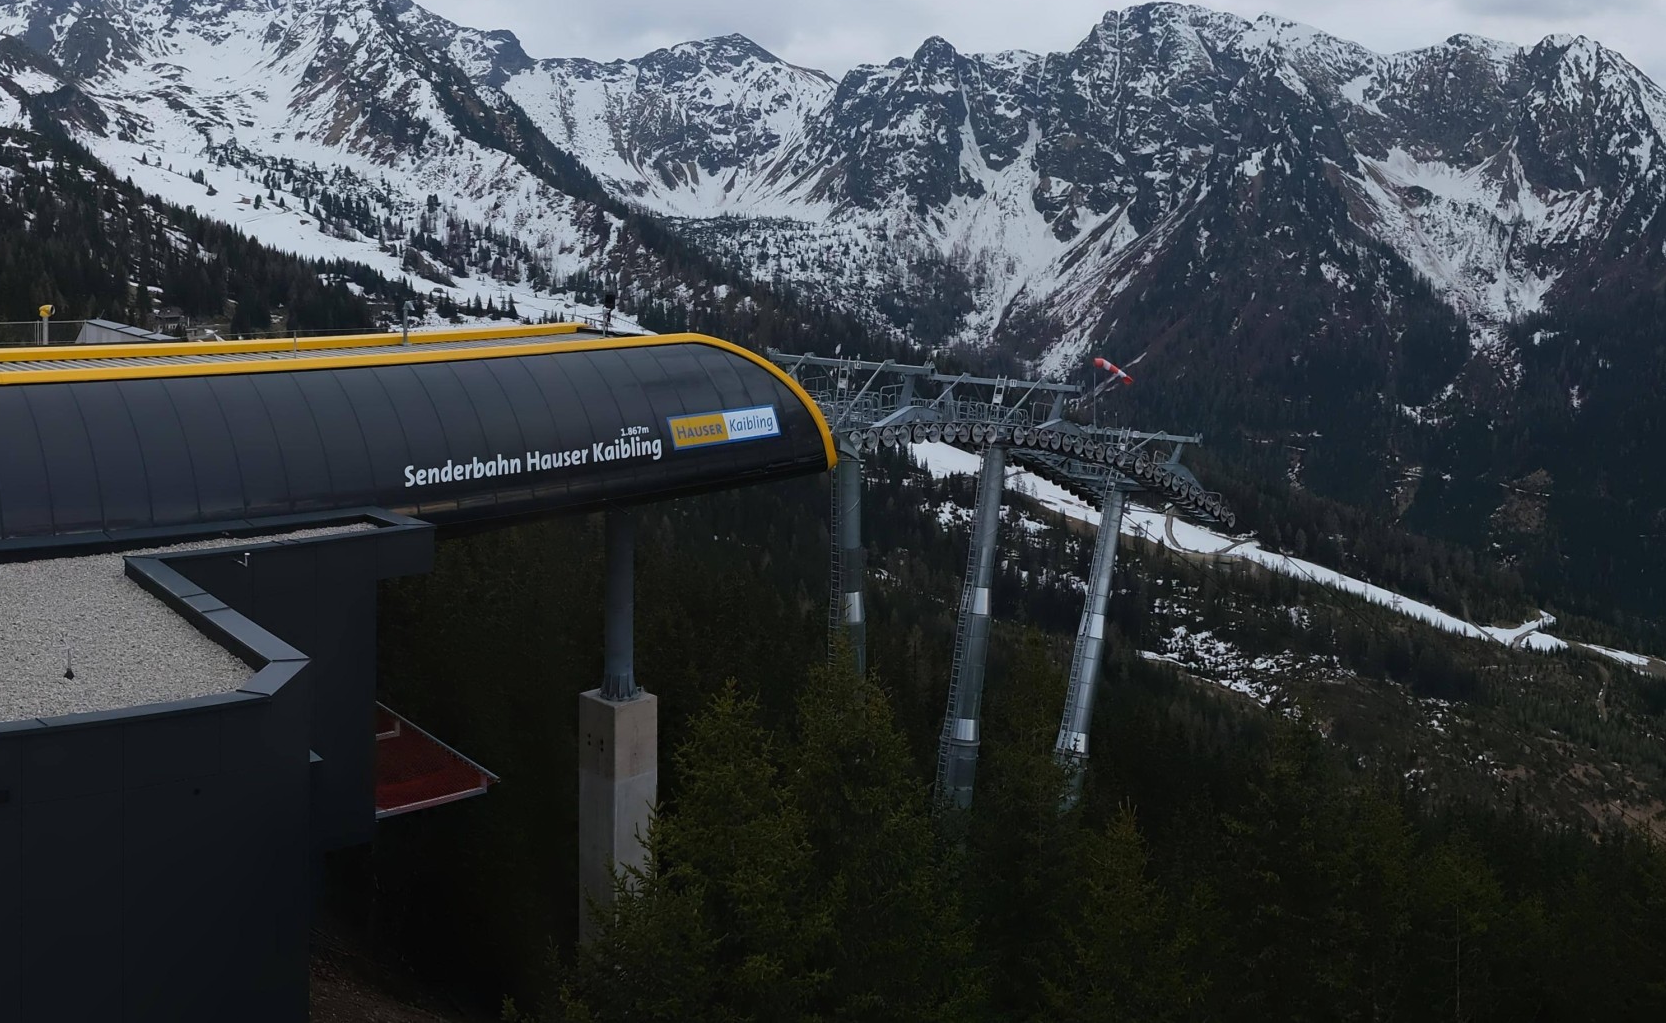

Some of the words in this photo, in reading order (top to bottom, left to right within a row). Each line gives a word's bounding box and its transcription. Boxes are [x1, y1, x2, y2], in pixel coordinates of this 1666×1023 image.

[620, 426, 649, 436] 1.867m
[676, 423, 723, 439] HAUSER
[729, 415, 773, 432] Kaibling
[404, 454, 521, 488] Senderbahn
[526, 448, 589, 472] Hauser
[592, 436, 662, 463] Kaibling
